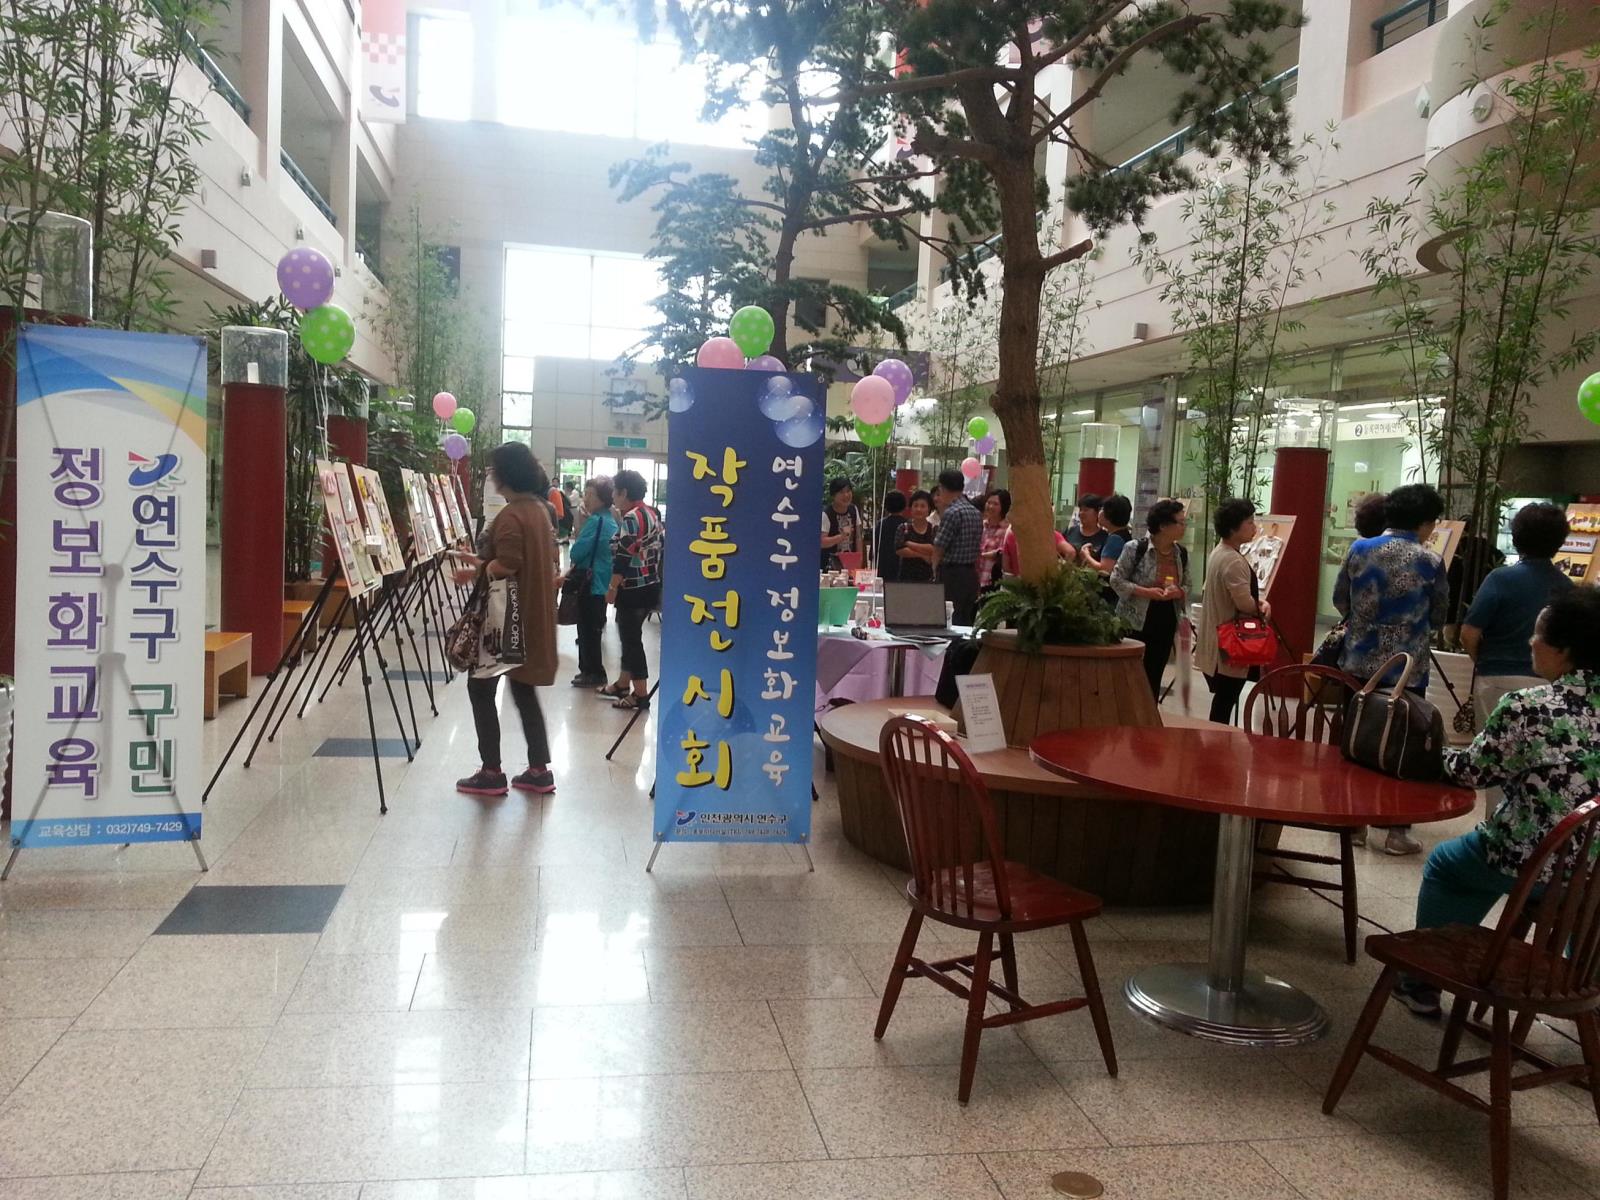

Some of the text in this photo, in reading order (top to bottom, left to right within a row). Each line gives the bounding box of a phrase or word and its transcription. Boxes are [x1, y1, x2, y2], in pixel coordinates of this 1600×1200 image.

[46, 447, 103, 797] 정보화교육
[128, 494, 179, 793] 연수구 구민
[511, 624, 520, 649] OPEN
[676, 447, 747, 789] 작품전시회
[761, 456, 803, 786] 연수구 정보화교육
[38, 825, 91, 838] 교육상담
[106, 822, 183, 835] 032)749-7429
[699, 812, 787, 825] 인천광역시 연수구
